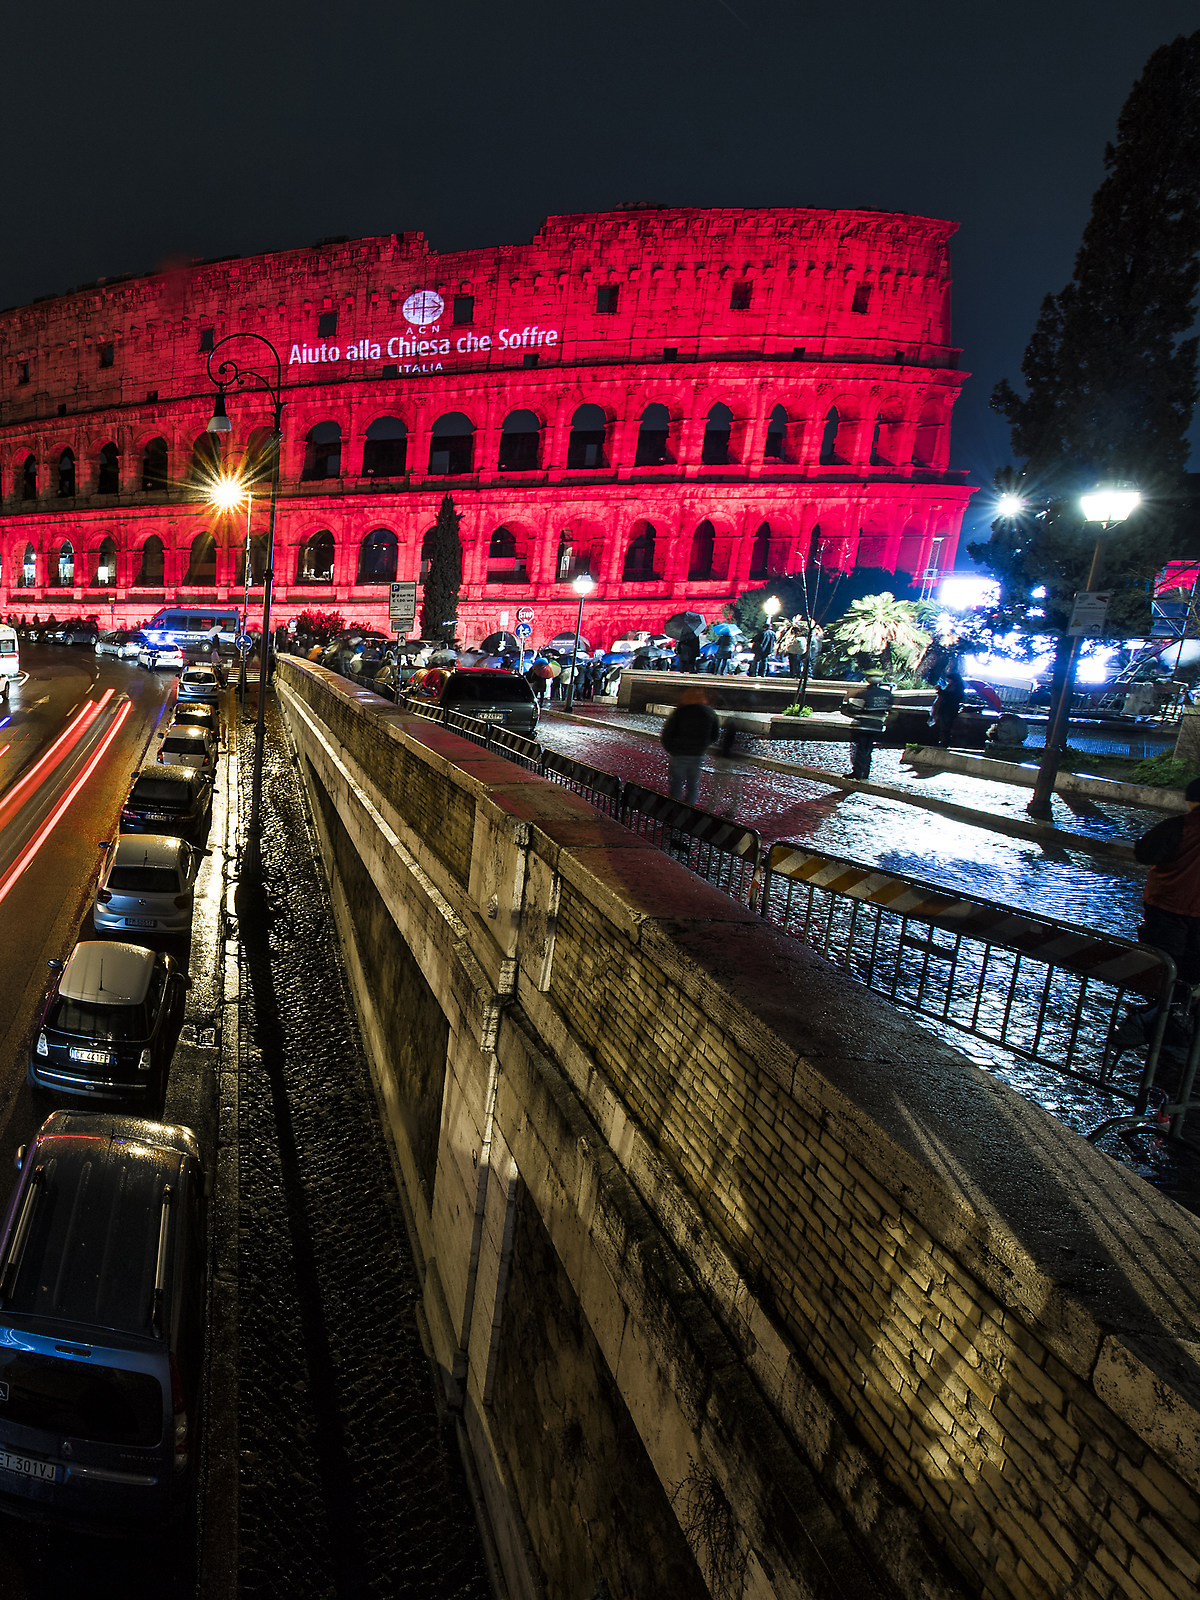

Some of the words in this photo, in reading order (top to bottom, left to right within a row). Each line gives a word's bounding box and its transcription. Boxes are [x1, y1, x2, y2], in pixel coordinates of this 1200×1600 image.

[405, 325, 440, 335] ACN
[288, 343, 341, 365] Aiuto
[345, 339, 382, 361] alla
[386, 335, 451, 359] Chiesa
[456, 332, 493, 353] che
[497, 326, 558, 350] Soffre
[398, 363, 443, 374] ITALIA
[15, 1457, 55, 1479] 301VJ
